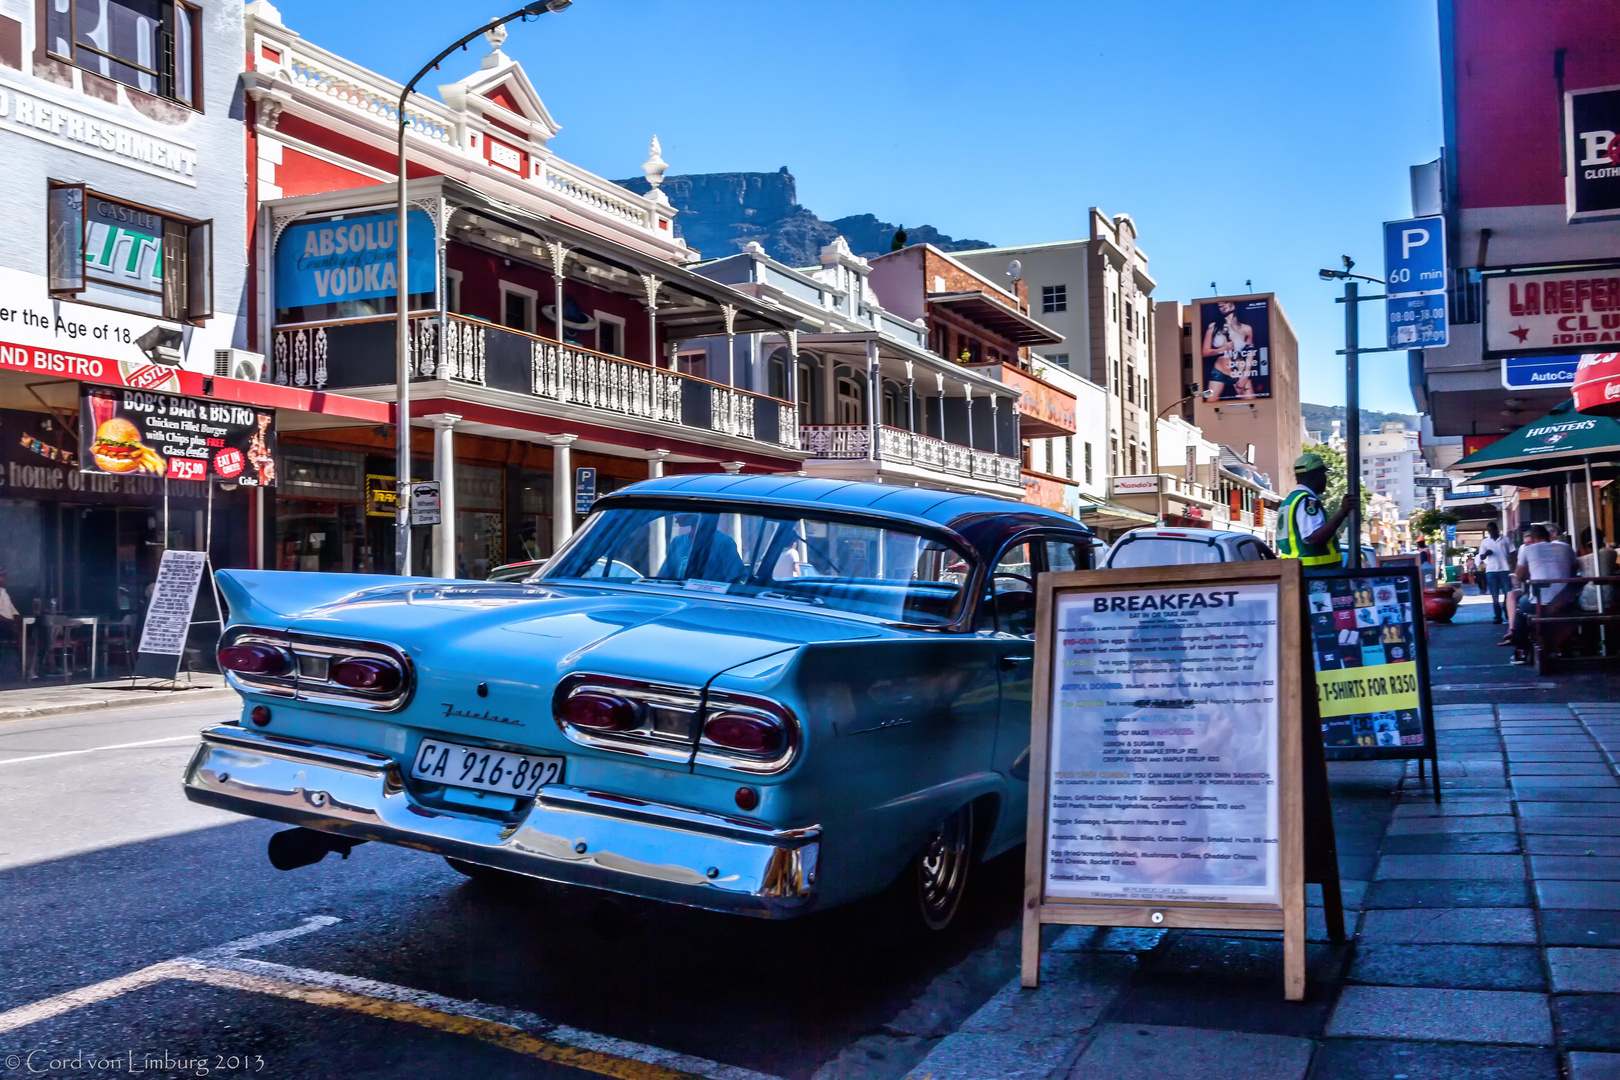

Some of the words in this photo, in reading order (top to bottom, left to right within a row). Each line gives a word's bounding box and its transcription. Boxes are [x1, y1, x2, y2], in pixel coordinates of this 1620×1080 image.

[15, 93, 197, 176] REFRESHMENT
[96, 200, 154, 229] CASTLE
[1402, 227, 1430, 259] P
[1389, 268, 1410, 284] 60
[1420, 269, 1443, 280] min
[23, 309, 49, 328] the
[55, 316, 87, 338] Age
[93, 325, 108, 340] of
[1229, 359, 1258, 368] broke
[1241, 349, 1258, 357] car
[34, 351, 103, 377] BISTRO
[1230, 369, 1258, 378] down
[130, 366, 170, 388] CASTLE
[123, 390, 166, 414] BOB'S
[169, 395, 197, 418] BAR
[199, 406, 207, 419] &
[210, 401, 254, 425] BISTRO
[146, 416, 179, 430] Chicken
[180, 421, 199, 432] Fillet
[201, 424, 228, 437] Burger
[1525, 420, 1597, 438] HUNTER'S
[145, 430, 166, 441] with
[166, 432, 189, 446] Chips
[189, 433, 206, 447] plus
[206, 438, 226, 448] FREE
[163, 445, 185, 457] Glass
[217, 457, 231, 468] EAT
[230, 451, 240, 464] IN
[9, 461, 63, 490] home
[238, 476, 259, 487] Coke
[582, 471, 592, 482] P
[1120, 481, 1153, 489] Nando's
[1093, 591, 1239, 613] BREAKFAST
[1322, 679, 1366, 701] T-SHIRTS
[1367, 677, 1388, 696] FOR
[1389, 673, 1416, 694] R350
[441, 702, 526, 726] Fairlane
[418, 744, 450, 777] CA
[459, 752, 559, 791] 916-892
